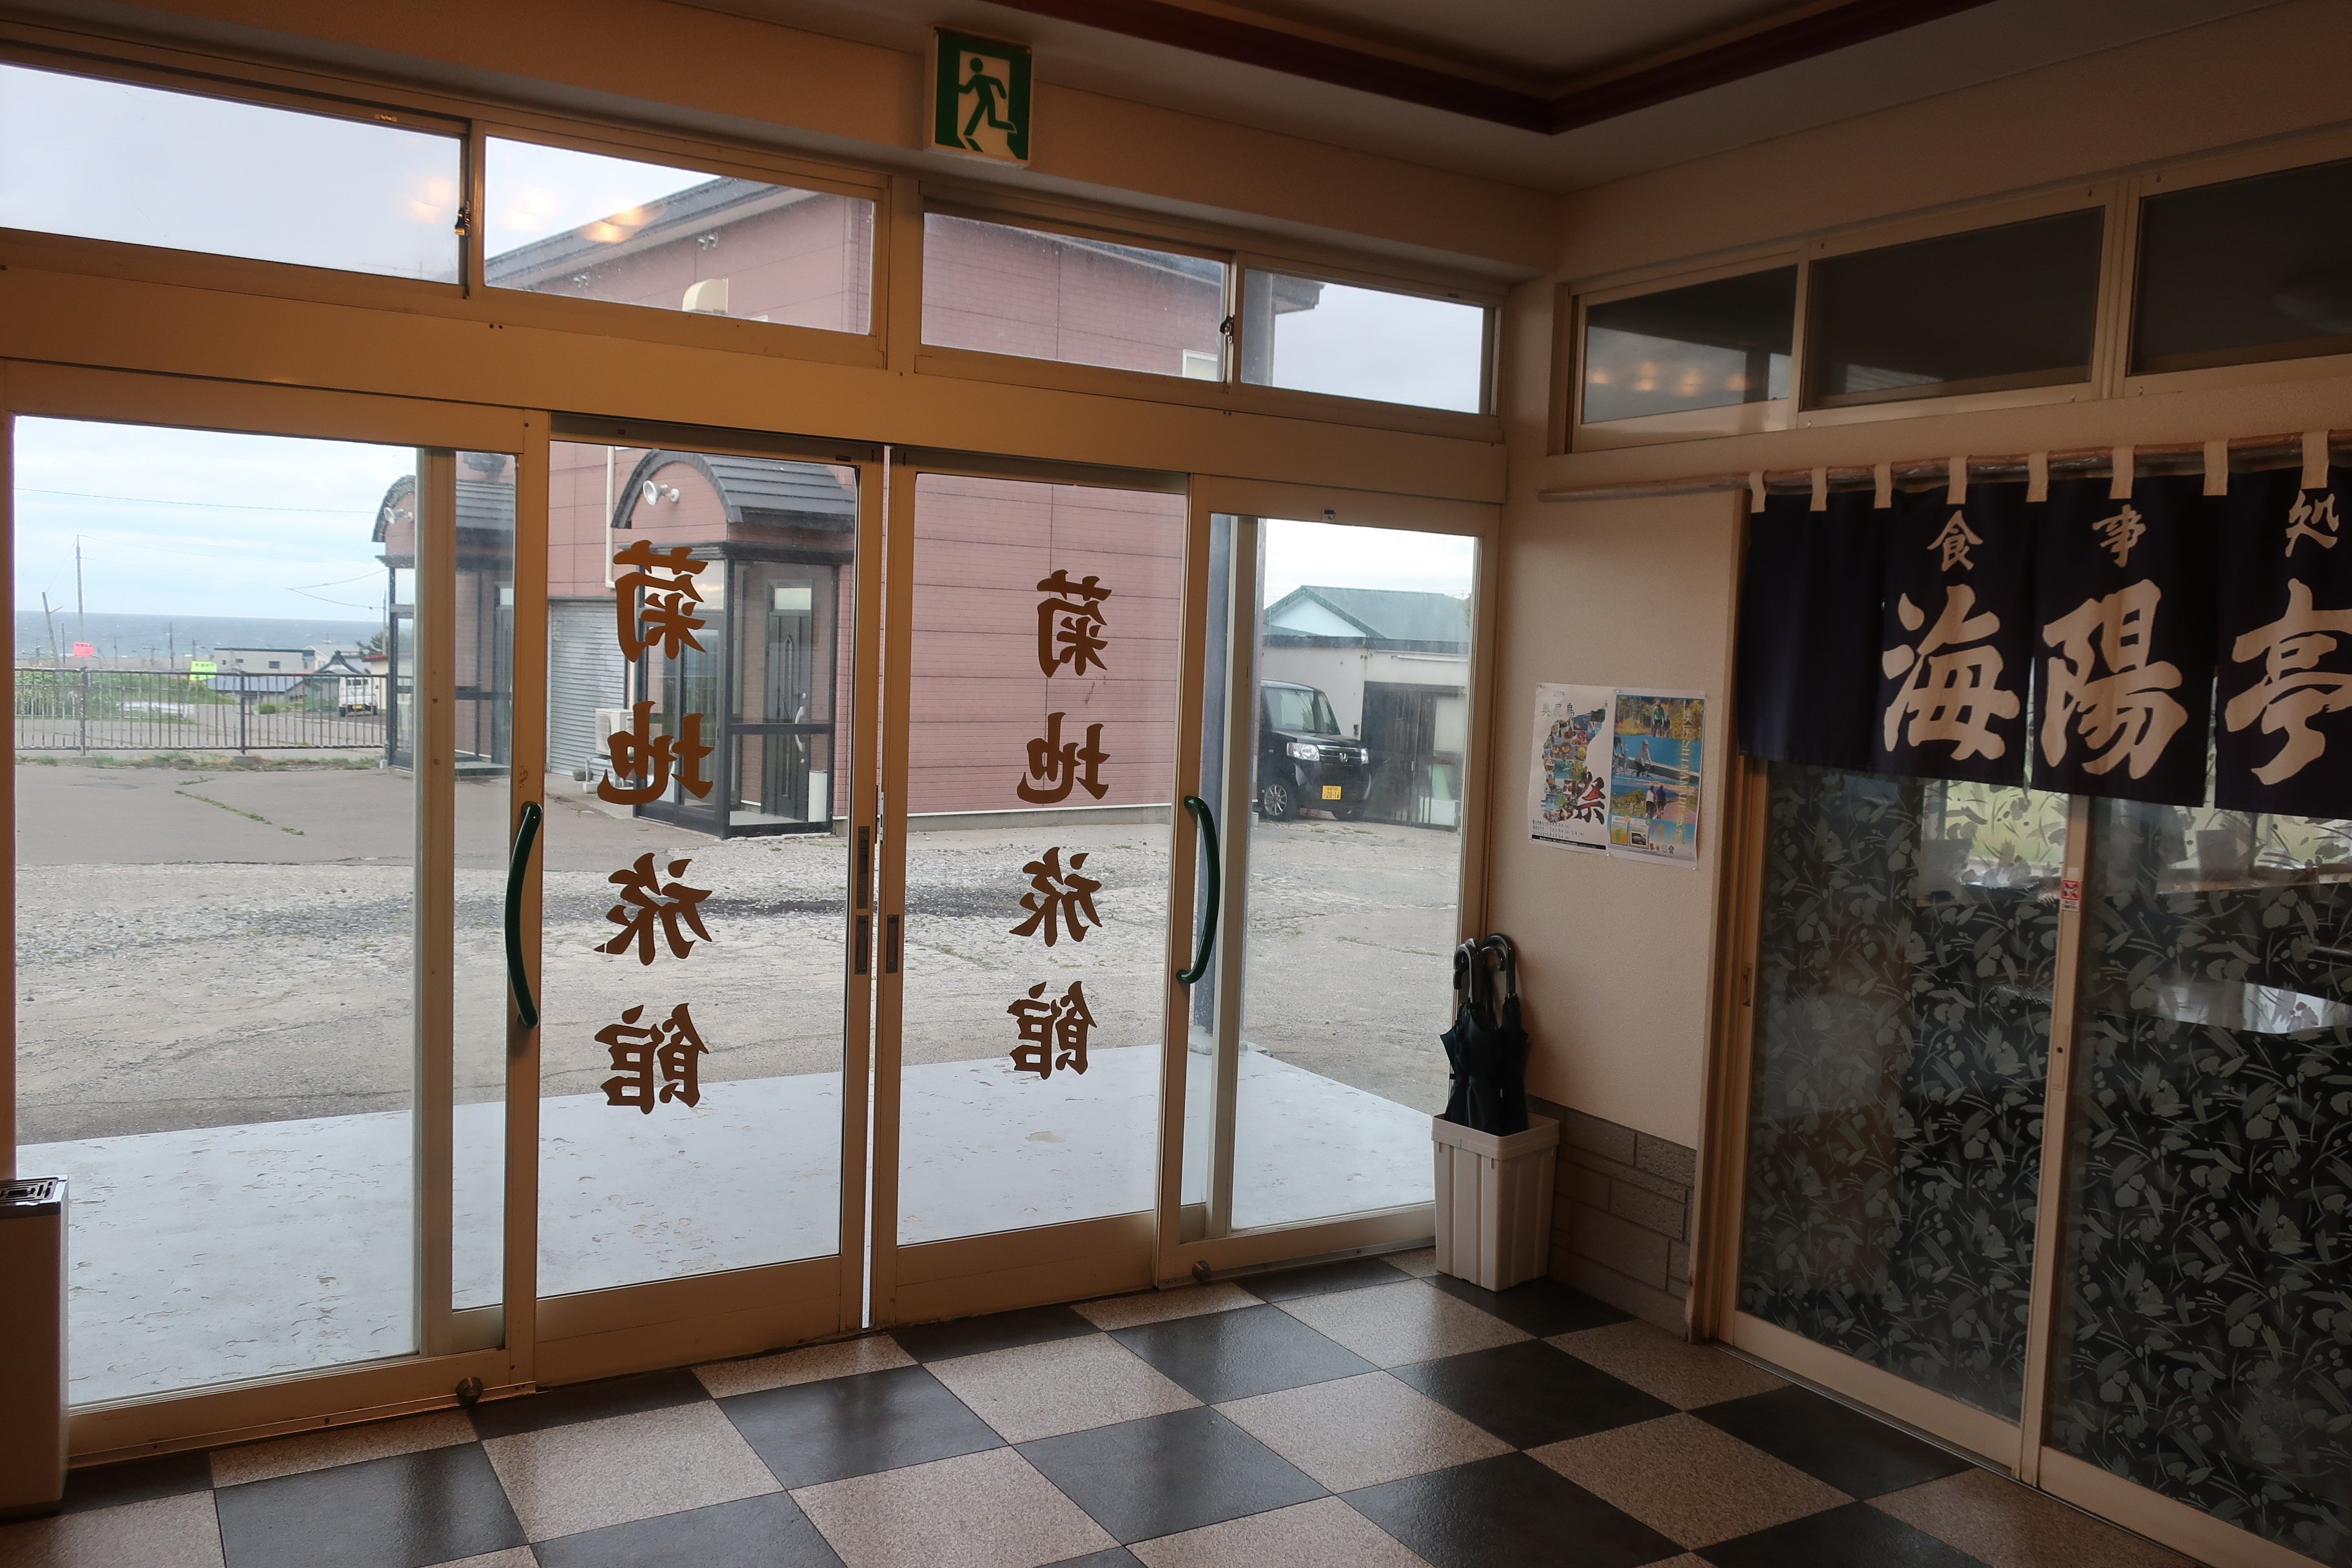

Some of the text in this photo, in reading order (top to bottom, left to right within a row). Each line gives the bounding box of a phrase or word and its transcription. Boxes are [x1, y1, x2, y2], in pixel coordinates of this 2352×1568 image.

[1928, 491, 2340, 571] 食事処
[1883, 578, 2352, 786] 海陽亭
[1574, 771, 1606, 825] 祭
